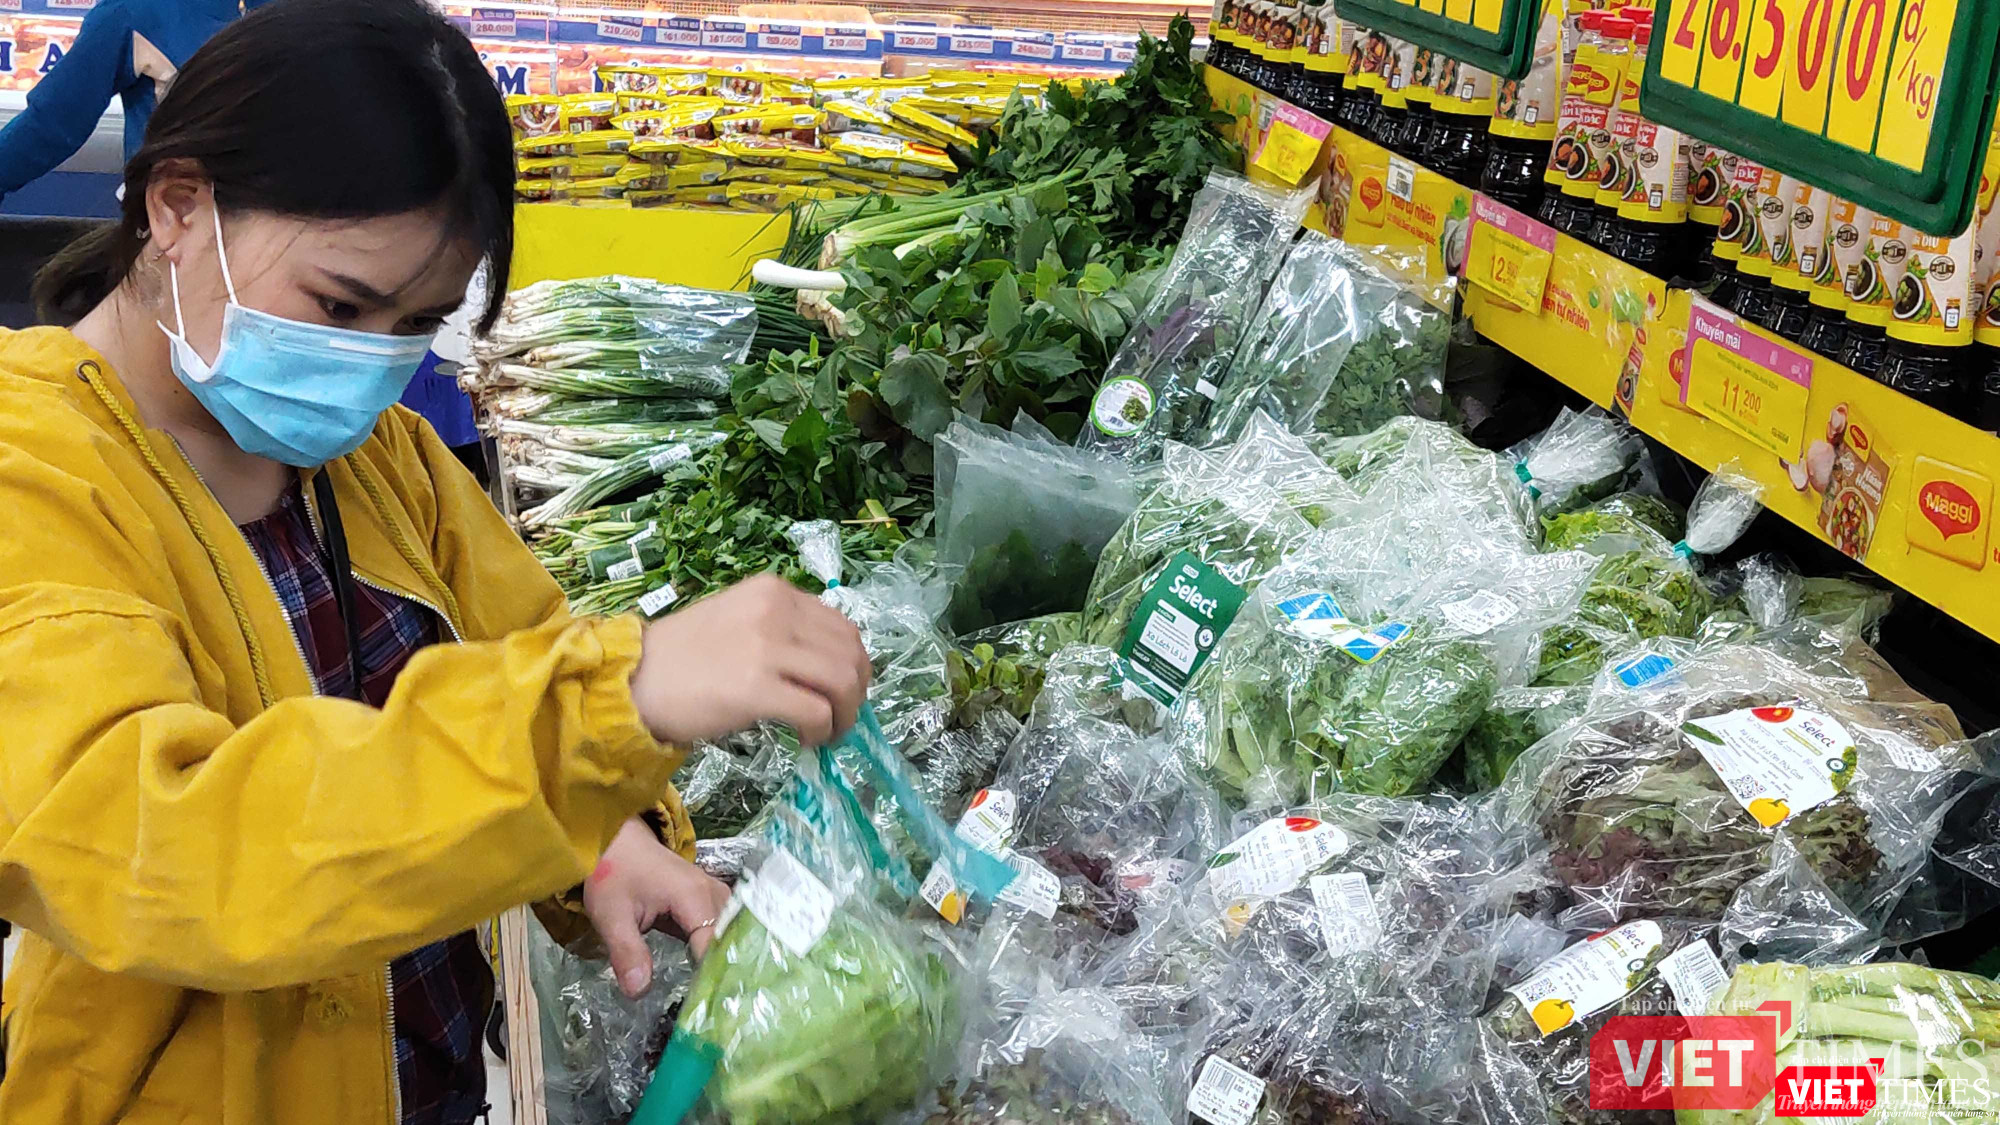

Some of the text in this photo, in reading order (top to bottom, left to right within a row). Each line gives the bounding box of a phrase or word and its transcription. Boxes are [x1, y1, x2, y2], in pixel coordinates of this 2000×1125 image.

[1694, 315, 1741, 350] Khuyến mãi
[1925, 491, 1974, 524] Maggi
[1168, 574, 1218, 619] Select
[1798, 720, 1836, 748] Select
